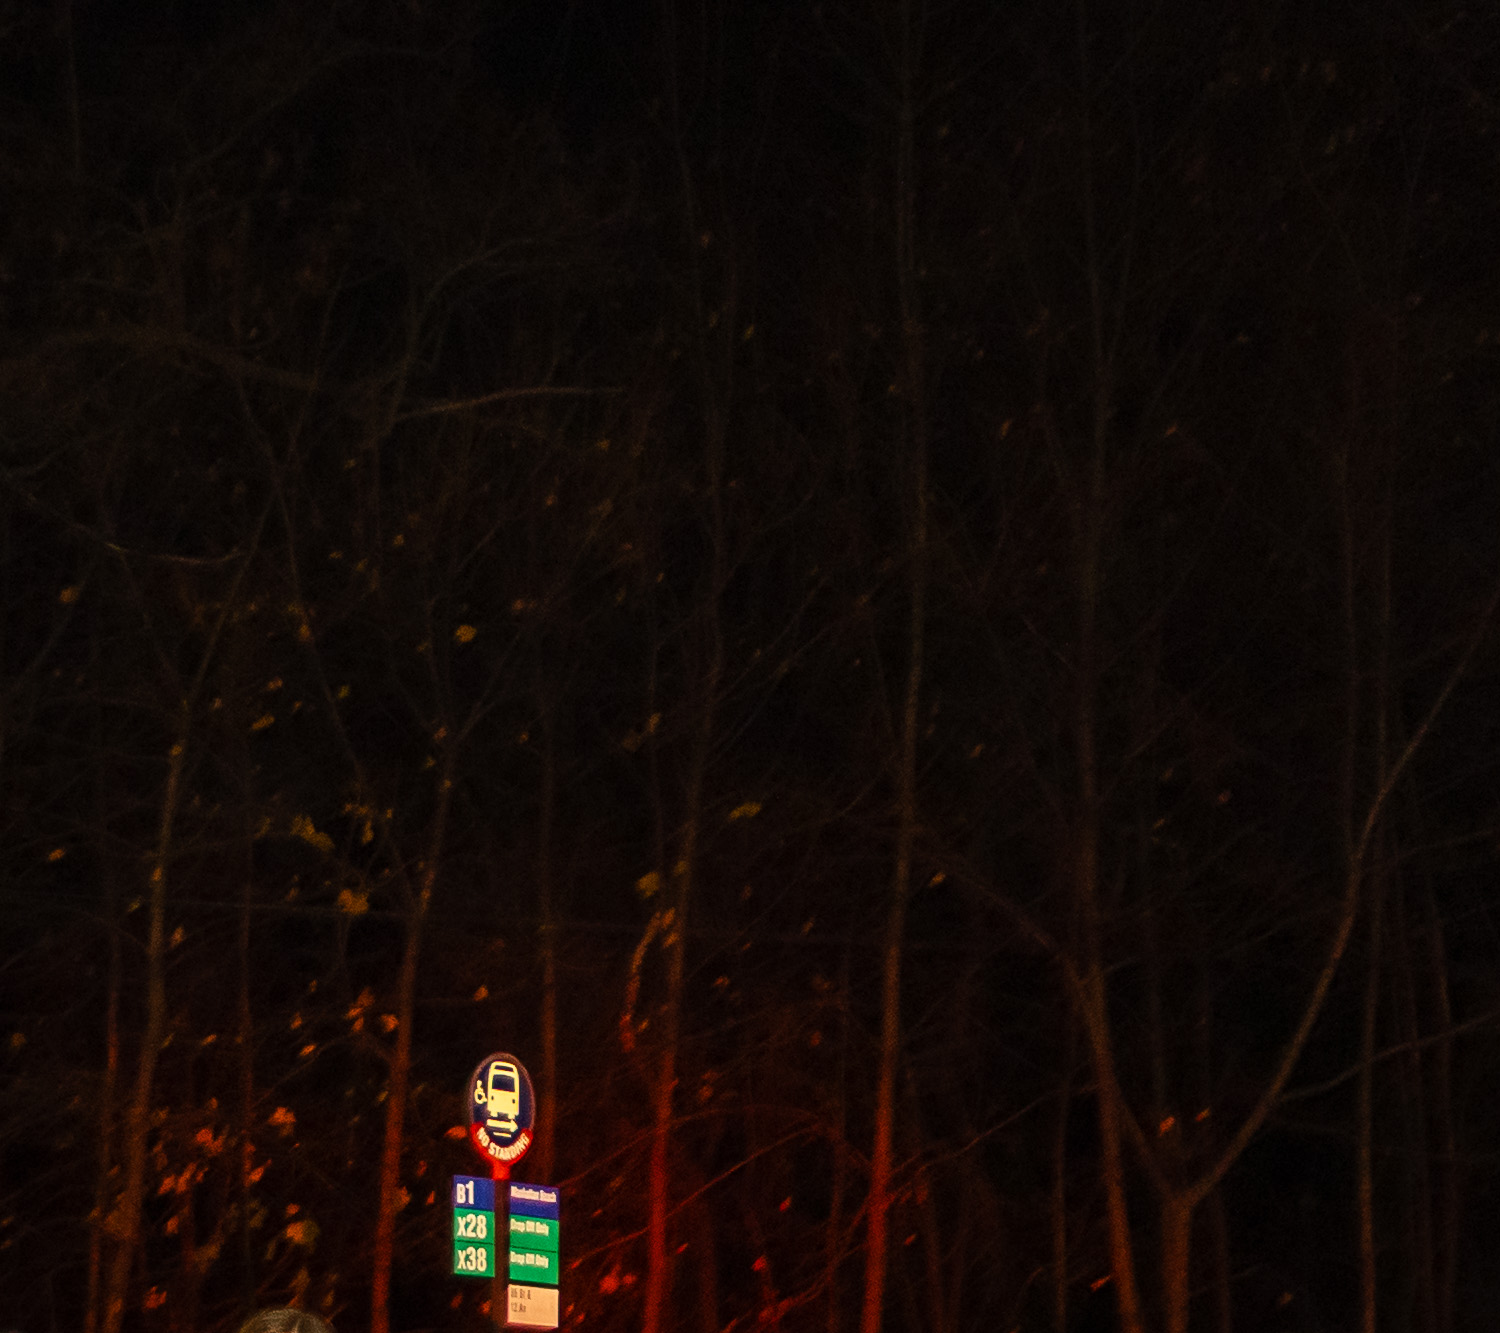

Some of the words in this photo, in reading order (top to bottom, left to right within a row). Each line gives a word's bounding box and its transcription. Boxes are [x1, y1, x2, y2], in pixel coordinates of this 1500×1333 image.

[476, 1126, 490, 1147] NO
[488, 1132, 530, 1161] STANDING
[456, 1180, 475, 1205] B1
